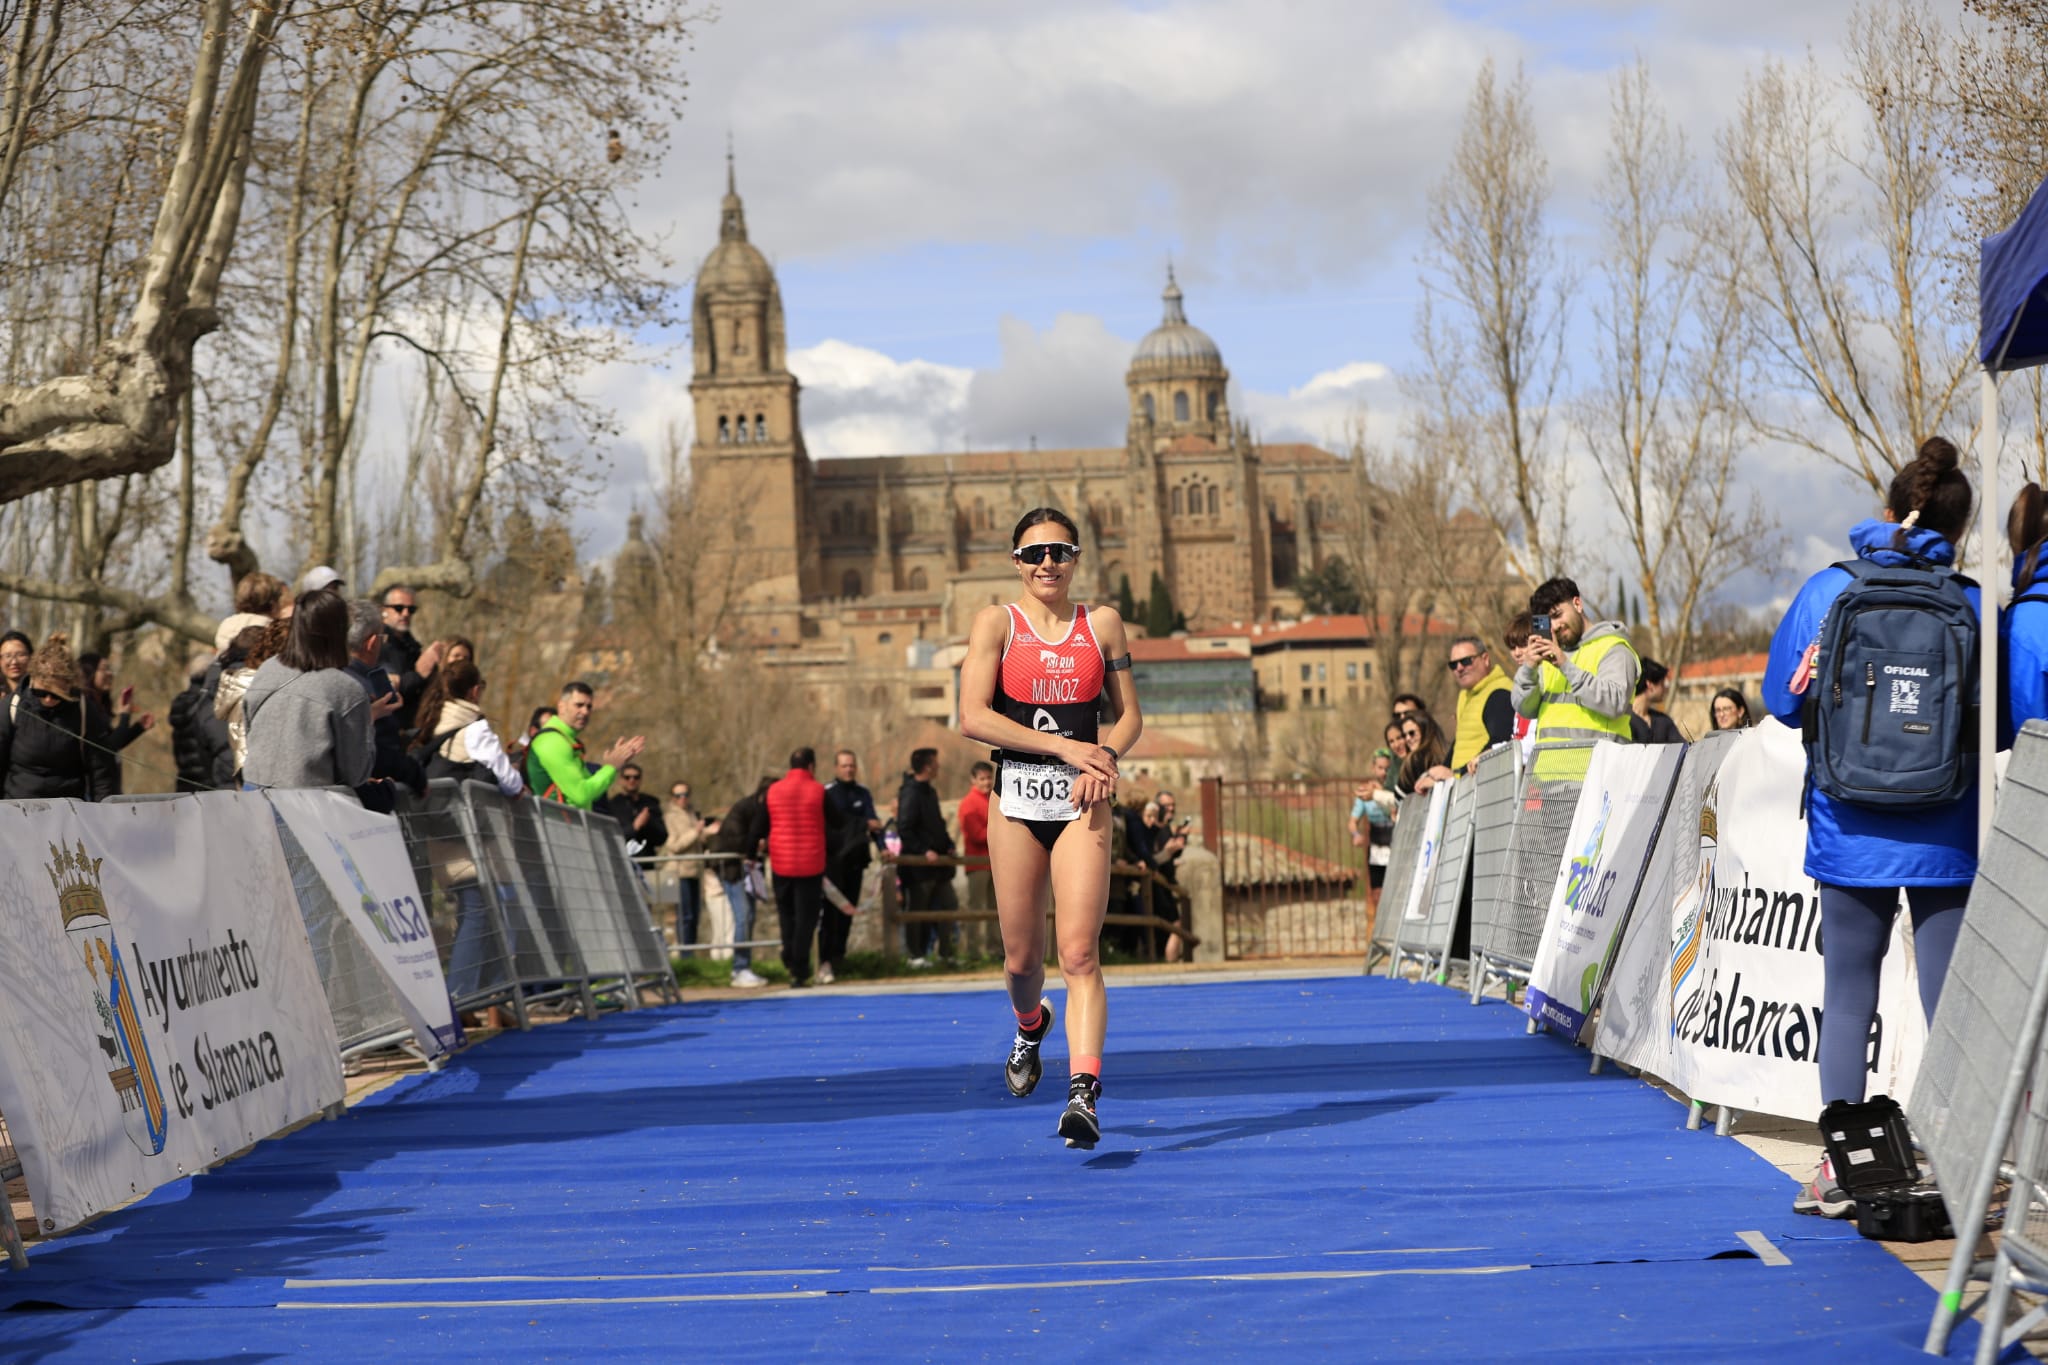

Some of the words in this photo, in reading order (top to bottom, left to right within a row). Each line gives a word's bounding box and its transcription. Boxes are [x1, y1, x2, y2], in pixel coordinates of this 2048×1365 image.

[1883, 665, 1930, 677] OFICIAL
[1032, 674, 1080, 702] MUÑOZ
[1013, 776, 1070, 801] 1503
